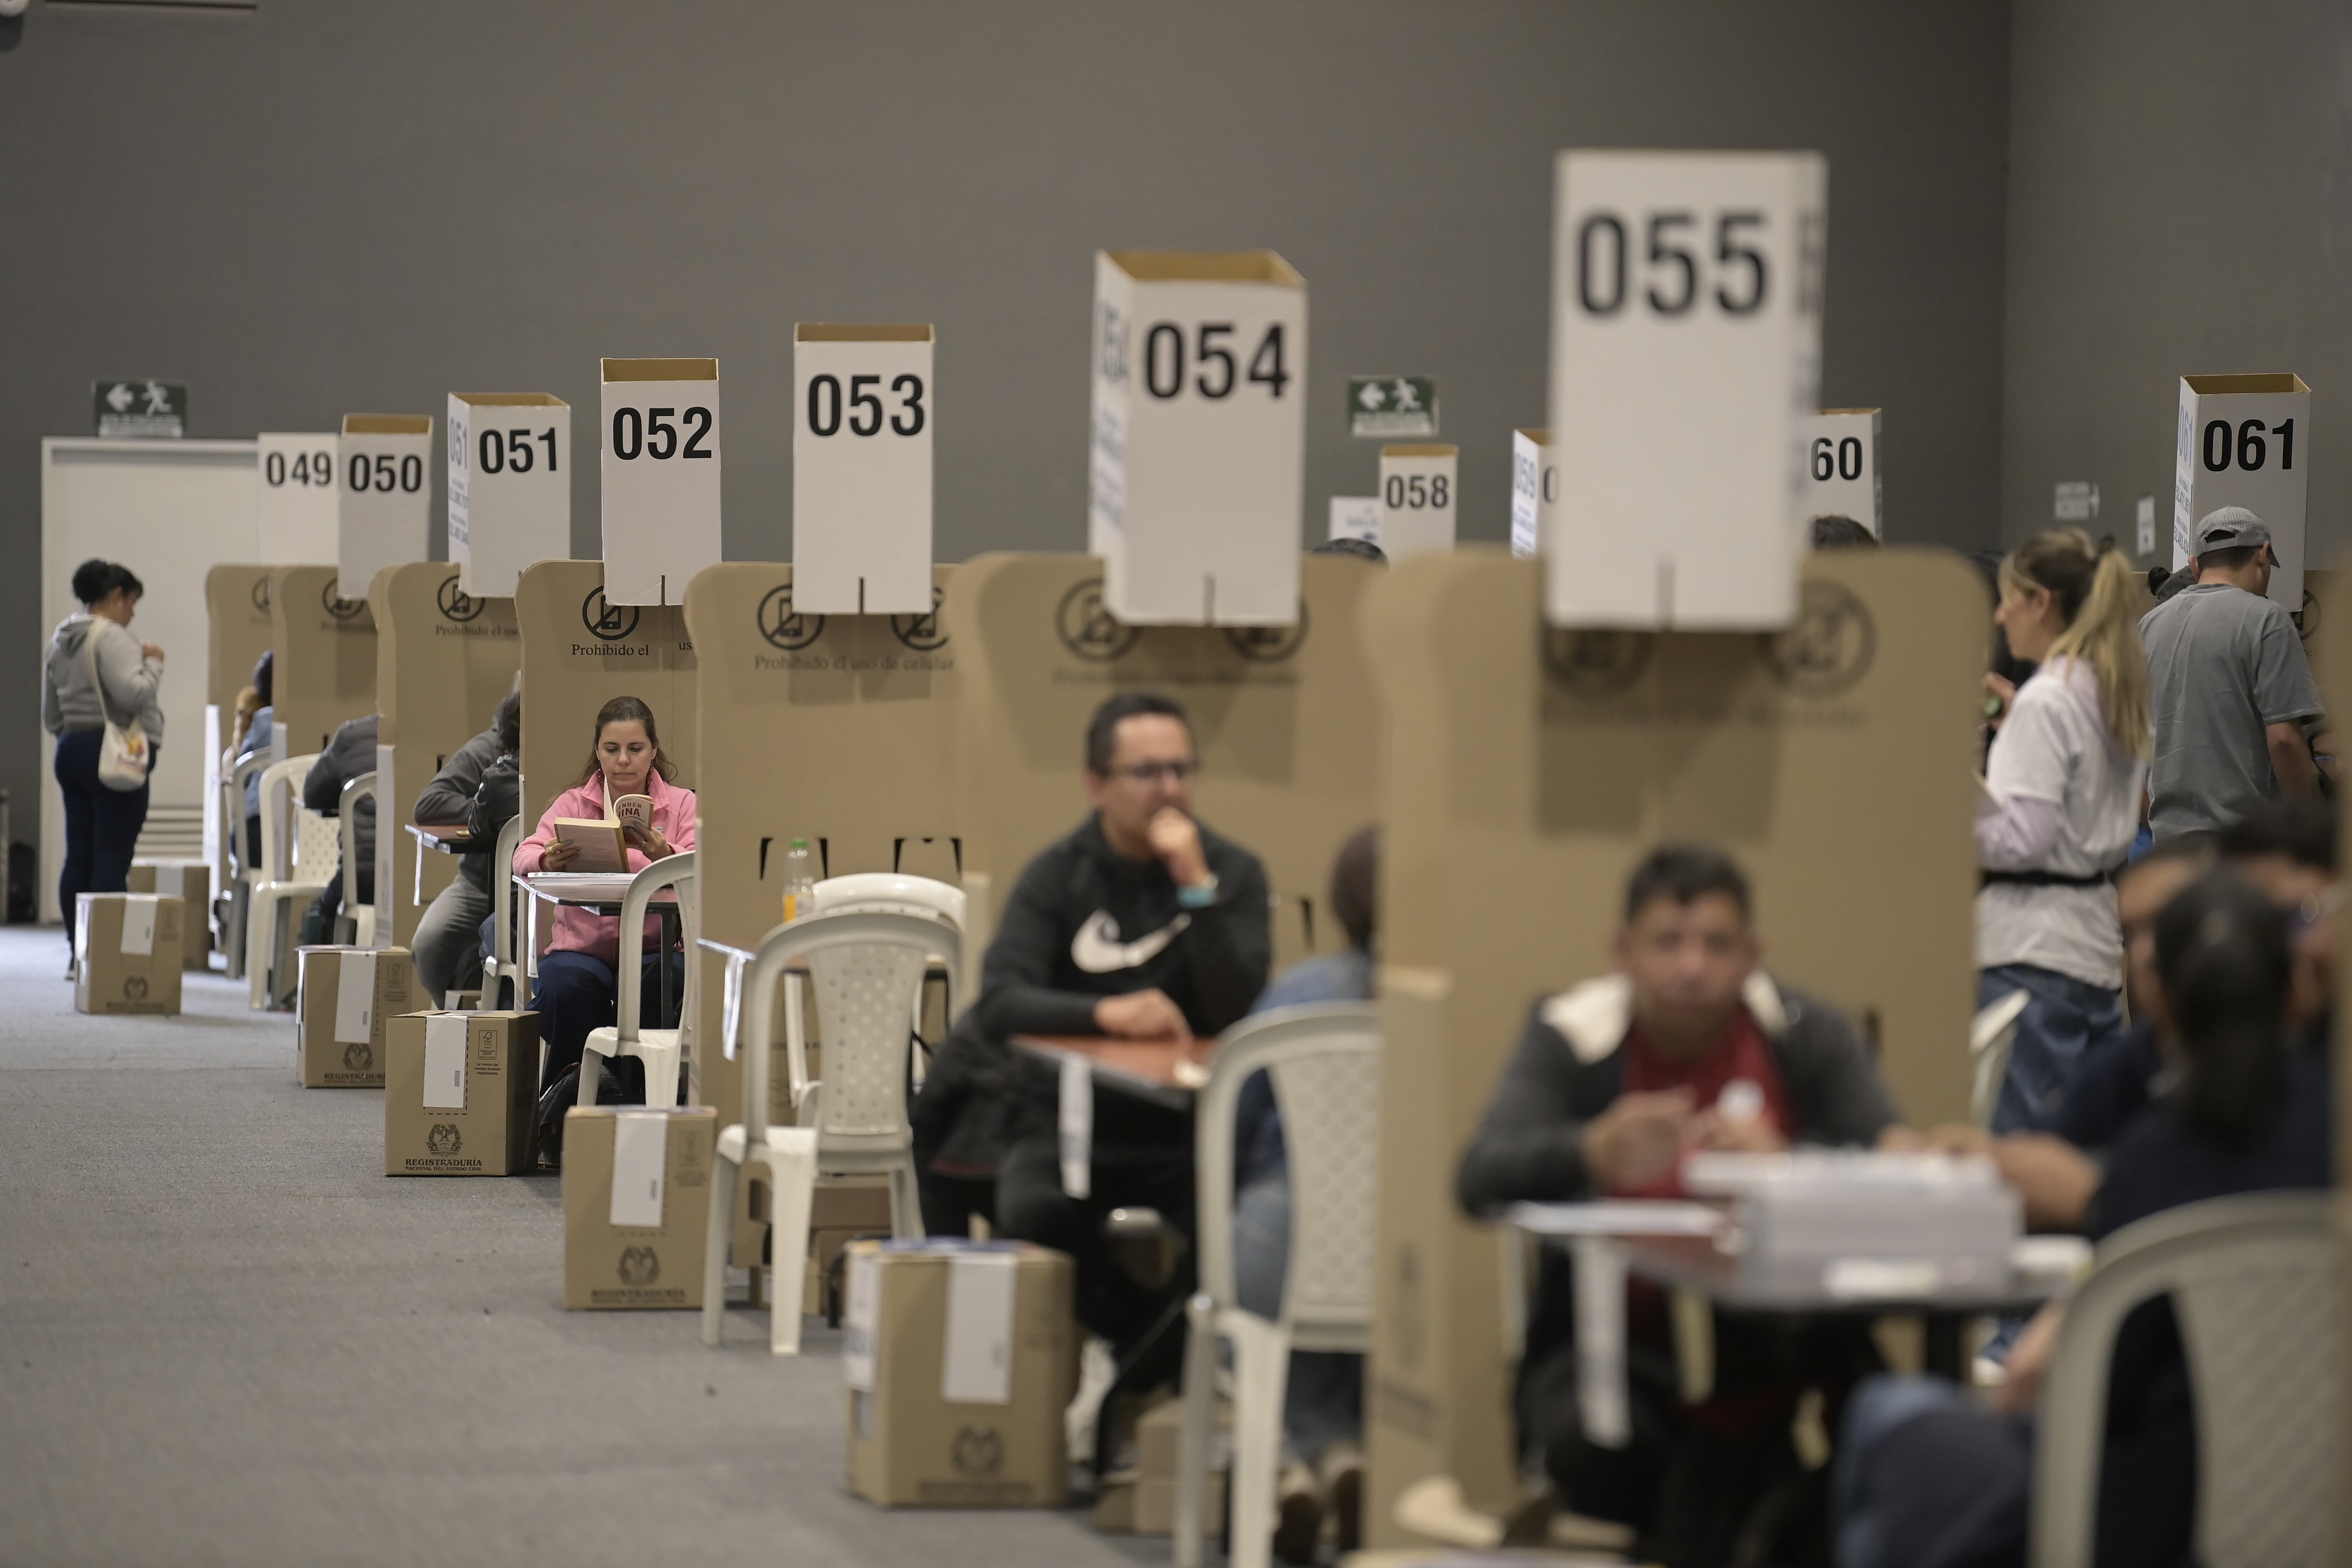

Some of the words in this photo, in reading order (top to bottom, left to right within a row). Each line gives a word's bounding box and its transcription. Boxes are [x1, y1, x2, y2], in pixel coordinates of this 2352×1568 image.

[1575, 210, 1770, 318] 055
[1144, 321, 1290, 400] 054
[808, 373, 925, 437] 053
[479, 427, 557, 474] 051
[613, 406, 712, 460] 052
[2179, 405, 2193, 467] 061
[2203, 418, 2294, 472] 061
[266, 452, 332, 486] 049
[348, 454, 422, 493] 050
[1811, 436, 1863, 482] 60
[1386, 475, 1449, 509] 058
[436, 625, 488, 635] Prohibido
[491, 625, 501, 635] el
[572, 644, 634, 655] Prohibido
[638, 644, 649, 655] el
[678, 642, 692, 650] us
[755, 656, 828, 670] Prohibido
[405, 1157, 482, 1166] REGISTRADURÍA
